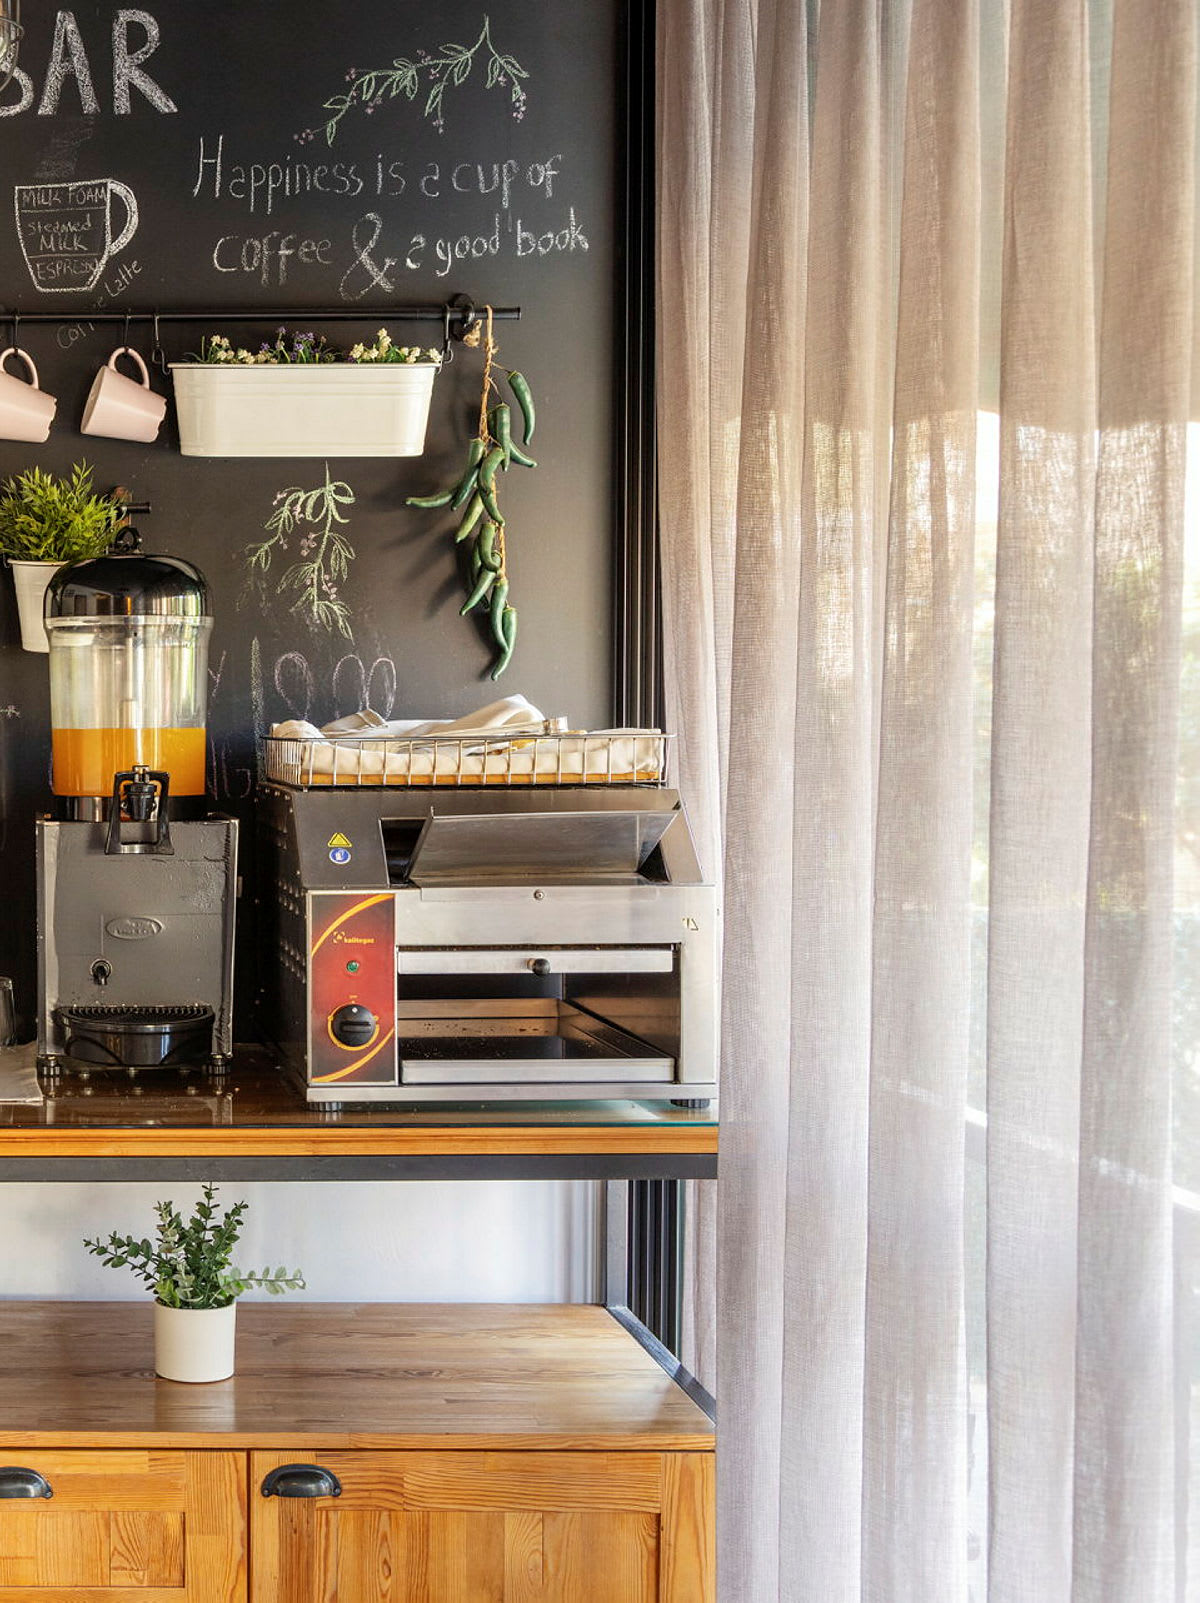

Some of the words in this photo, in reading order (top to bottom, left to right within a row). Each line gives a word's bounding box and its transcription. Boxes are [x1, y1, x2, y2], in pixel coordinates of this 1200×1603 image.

[68, 185, 107, 205] FOAM
[193, 134, 363, 214] Happiness
[377, 154, 405, 195] is
[420, 165, 440, 197] a
[452, 158, 518, 208] cup
[526, 154, 564, 199] of
[104, 260, 142, 297] Latte
[339, 212, 398, 300] &
[405, 234, 426, 269] a
[436, 213, 500, 277] good
[516, 207, 589, 257] book
